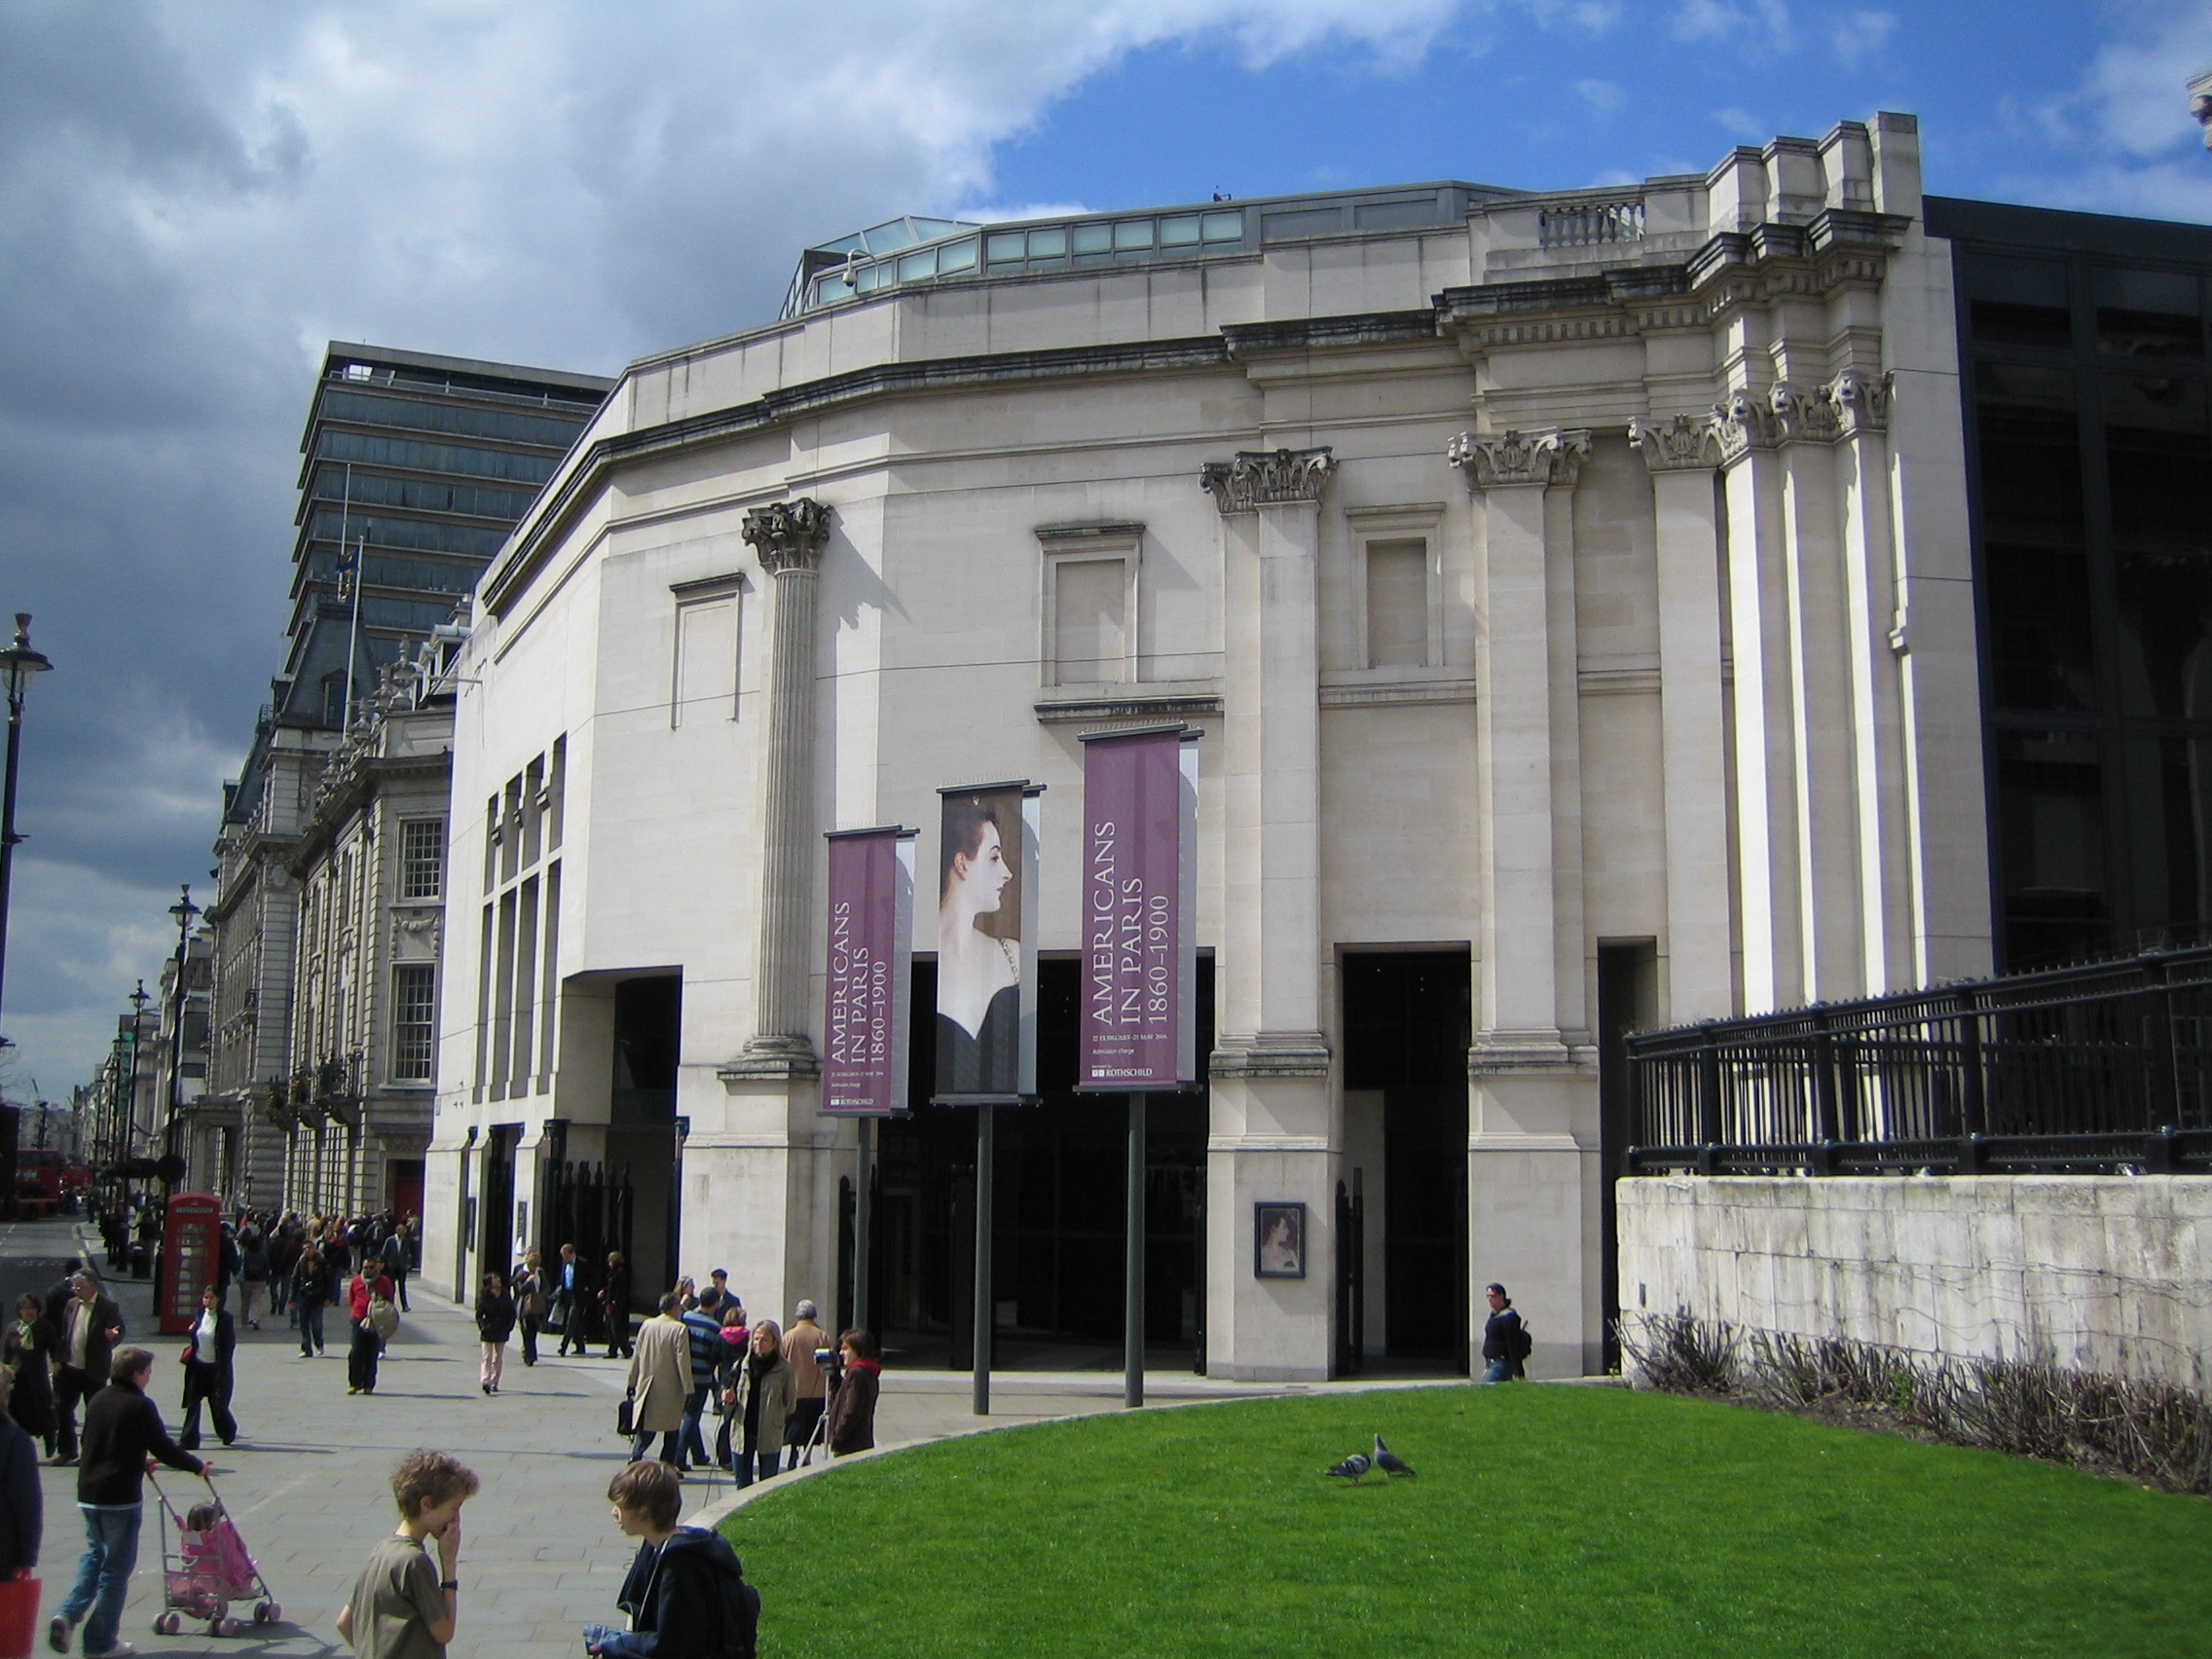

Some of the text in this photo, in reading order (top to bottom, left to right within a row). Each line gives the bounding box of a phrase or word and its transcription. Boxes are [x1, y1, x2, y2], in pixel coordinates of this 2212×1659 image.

[830, 902, 851, 1065] AMERICANS
[1091, 821, 1116, 1026] AMERICANS
[1120, 877, 1143, 1024] IN PARIS
[850, 946, 869, 1063] IN PARIS
